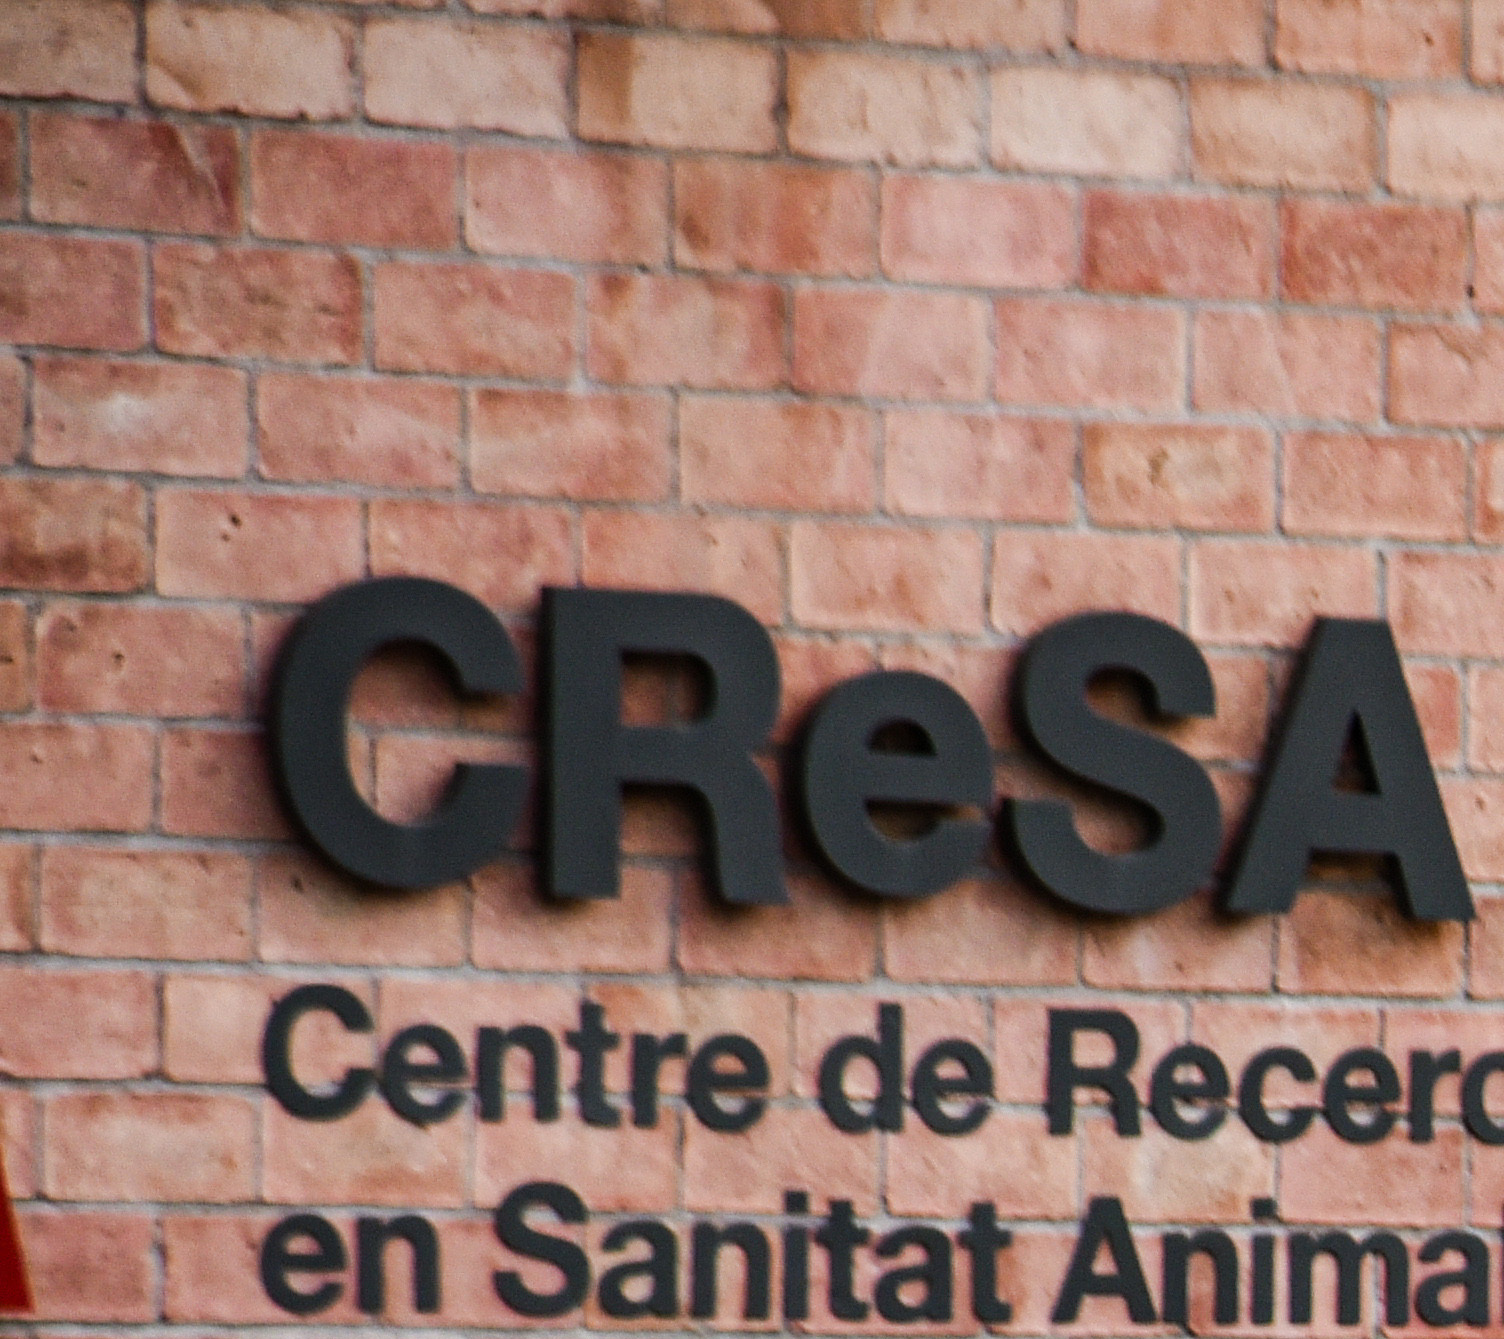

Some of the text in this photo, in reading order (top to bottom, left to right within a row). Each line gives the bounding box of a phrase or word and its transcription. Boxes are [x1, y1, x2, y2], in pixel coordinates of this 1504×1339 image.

[273, 576, 1476, 923] CReSA
[262, 986, 770, 1134] Centre
[819, 1004, 995, 1138] de
[261, 1209, 439, 1315] en
[497, 1181, 1012, 1326] Sanitat
